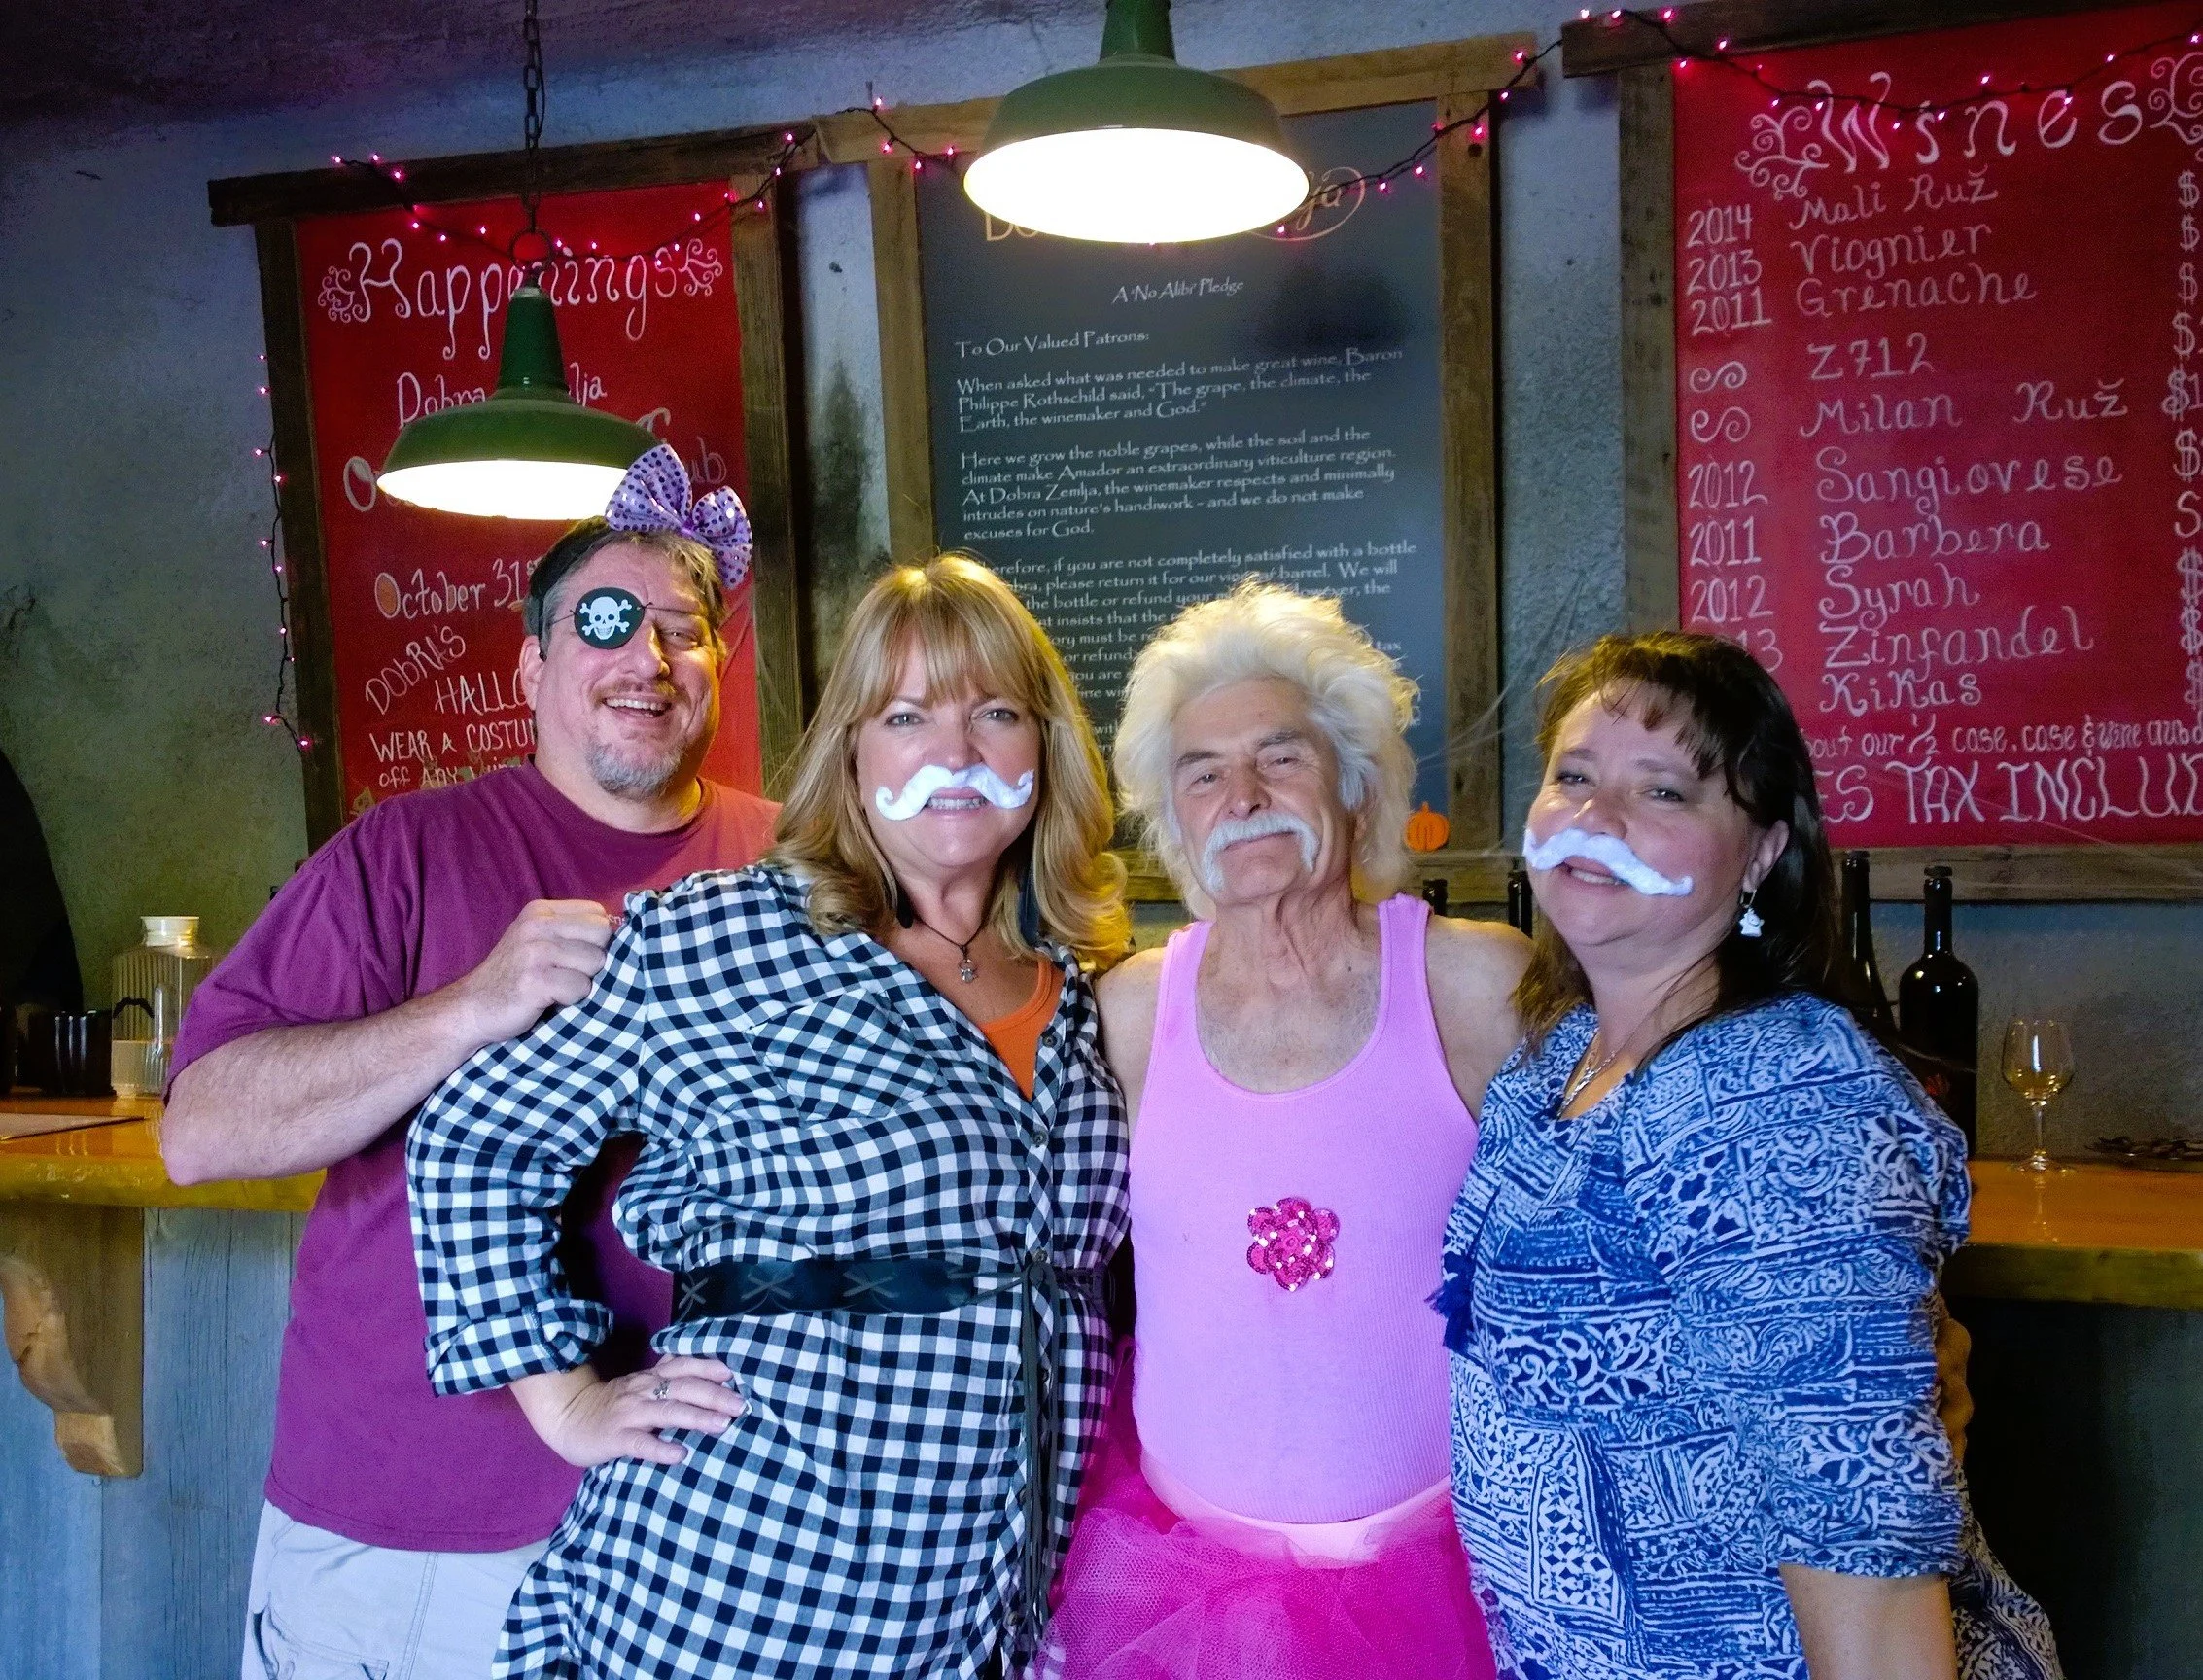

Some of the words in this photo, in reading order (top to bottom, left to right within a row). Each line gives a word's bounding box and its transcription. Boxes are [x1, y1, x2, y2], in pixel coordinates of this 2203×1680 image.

[1807, 71, 2143, 173] Wines
[1686, 203, 1753, 250] 2014
[1789, 182, 1887, 230] Mali
[1686, 249, 1762, 295] 2013
[1790, 223, 1993, 281] Viognier
[1200, 276, 1244, 297] Pledge
[1795, 263, 2037, 318] Grenache
[1691, 292, 1772, 337] 2011
[955, 340, 982, 359] To
[986, 338, 1021, 356] Our
[1024, 332, 1080, 353] Valued
[1083, 331, 1150, 348] Patrons:
[1807, 332, 1935, 381] Z712
[957, 377, 1002, 395] When
[1007, 371, 1051, 389] asked
[1055, 369, 1090, 387] what
[1094, 372, 1123, 383] was
[1127, 361, 1185, 380] needed
[1190, 363, 1206, 375] to
[1210, 357, 1250, 373] make
[1253, 356, 1296, 375] great
[1346, 347, 1403, 366] Baron
[959, 396, 1019, 415] Philippe
[1023, 387, 1105, 409] Rothschild
[1250, 375, 1276, 390] the
[1345, 368, 1372, 382] the
[397, 372, 486, 430] Dobra
[1014, 412, 1038, 427] the
[1041, 405, 1121, 426] winemaker
[1123, 402, 1152, 418] and
[1800, 394, 1963, 438] Milan
[2012, 377, 2128, 424] Ruž
[961, 451, 1001, 470] Here
[1005, 454, 1025, 465] we
[1030, 452, 1066, 468] grow
[1069, 444, 1094, 460] the
[1097, 440, 1140, 458] noble
[1206, 434, 1243, 452] while
[1248, 432, 1274, 448] the
[1278, 429, 1306, 446] soil
[1310, 427, 1340, 443] and
[1344, 426, 1372, 441] the
[962, 471, 1013, 486] climate
[1015, 466, 1054, 482] make
[1058, 462, 1121, 480] Amador
[1125, 465, 1144, 474] an
[1148, 454, 1254, 474] extraordinary
[1257, 448, 1336, 467] viticulture
[961, 488, 985, 507] At
[990, 485, 1041, 505] Dobra
[1104, 480, 1130, 495] the
[1133, 475, 1217, 494] winemaker
[1218, 473, 1286, 492] respects
[1290, 468, 1320, 484] and
[1324, 463, 1395, 483] minimally
[963, 505, 1024, 522] intrudes
[1027, 508, 1046, 518] on
[1050, 503, 1111, 517] nature's
[1115, 494, 1193, 512] handiwork
[1207, 491, 1237, 508] and
[1240, 495, 1262, 506] we
[1265, 489, 1287, 505] do
[1291, 490, 1318, 503] not
[1322, 484, 1364, 501] make
[1687, 459, 1769, 510] 2012
[1816, 446, 2123, 514] Sangiovese
[964, 528, 1022, 540] excuses
[1026, 521, 1049, 537] for
[1052, 519, 1095, 538] God.
[1688, 516, 1762, 567] 2011
[1819, 512, 2050, 566] Barbera
[1046, 576, 1094, 596] please
[1099, 577, 1145, 588] return
[1148, 575, 1158, 585] it
[1162, 571, 1187, 585] for
[1189, 574, 1216, 584] our
[1338, 562, 1370, 578] We
[1373, 559, 1398, 575] will
[1054, 557, 1065, 572] if
[1067, 560, 1095, 576] you
[1099, 559, 1124, 570] are
[1128, 556, 1153, 568] not
[1157, 548, 1241, 570] completely
[1245, 543, 1312, 562] satisfied
[1316, 542, 1349, 558] with
[1352, 548, 1362, 557] a
[1367, 540, 1417, 556] bottle
[374, 568, 486, 619] October
[1025, 595, 1049, 611] the
[1054, 592, 1099, 610] bottle
[1102, 598, 1119, 607] or
[1122, 589, 1172, 606] refund
[1364, 579, 1392, 595] the
[1690, 574, 1774, 623] 2012
[1819, 563, 1981, 632] Syrah
[1057, 613, 1104, 628] insists
[1107, 611, 1138, 625] that
[1141, 609, 1167, 623] the
[1079, 633, 1113, 645] must
[1118, 628, 1137, 642] be
[1064, 653, 1080, 663] or
[1083, 647, 1133, 662] refund
[1819, 606, 2095, 681] Zinfandel
[1098, 670, 1122, 680] are
[369, 730, 434, 763] WEAR
[441, 732, 457, 754] A
[466, 719, 536, 752] COSTU
[1804, 726, 1852, 759] bout
[1862, 732, 1905, 757] our
[1885, 756, 1986, 824] TAX
